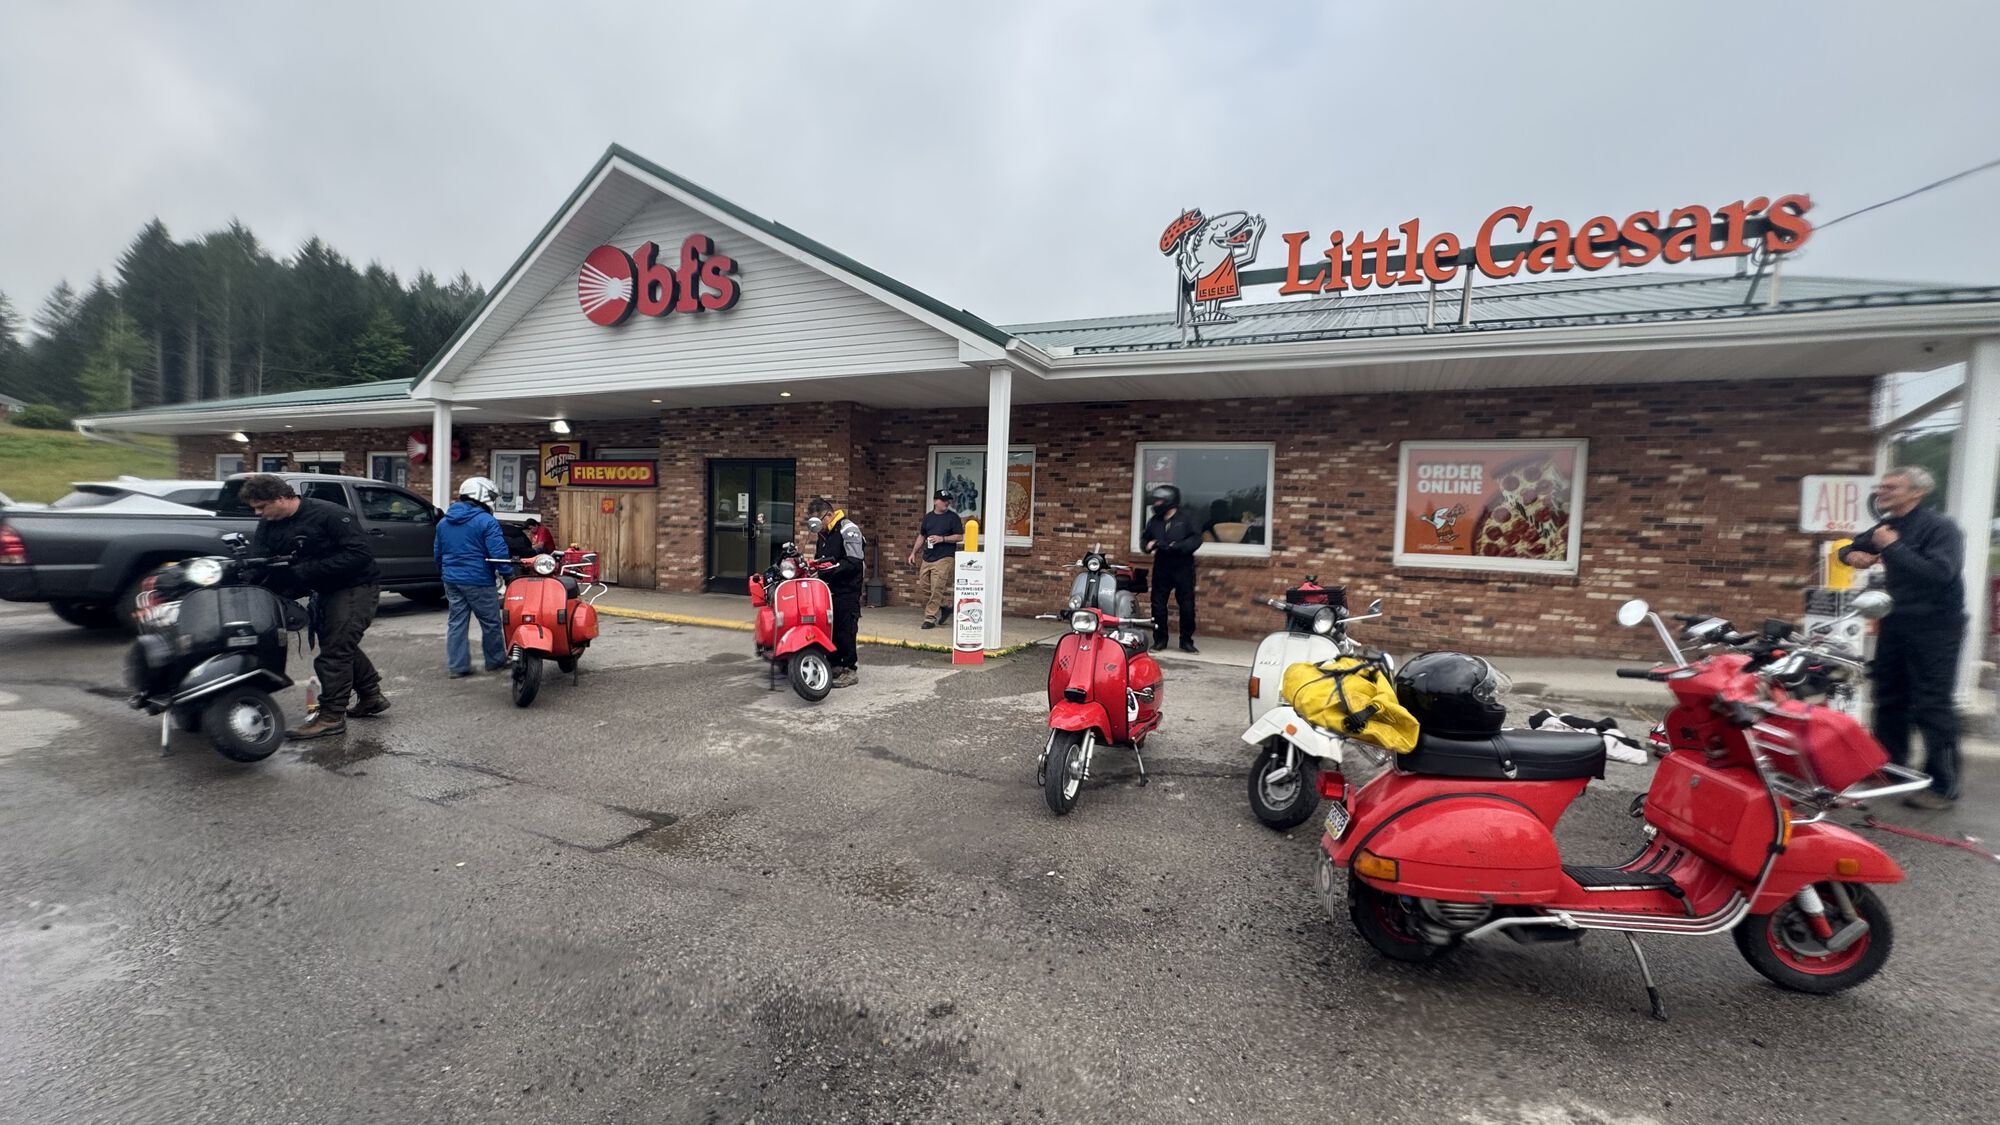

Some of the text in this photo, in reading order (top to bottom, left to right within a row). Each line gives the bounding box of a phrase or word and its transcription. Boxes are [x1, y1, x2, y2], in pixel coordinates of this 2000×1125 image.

[1279, 192, 1814, 296] Little Caesars
[632, 233, 741, 318] bfs
[545, 455, 558, 473] HOT
[574, 466, 650, 480] FIREWOOD
[1418, 464, 1483, 480] ORDER
[1418, 480, 1482, 495] ONLINE
[1814, 480, 1859, 521] AIR
